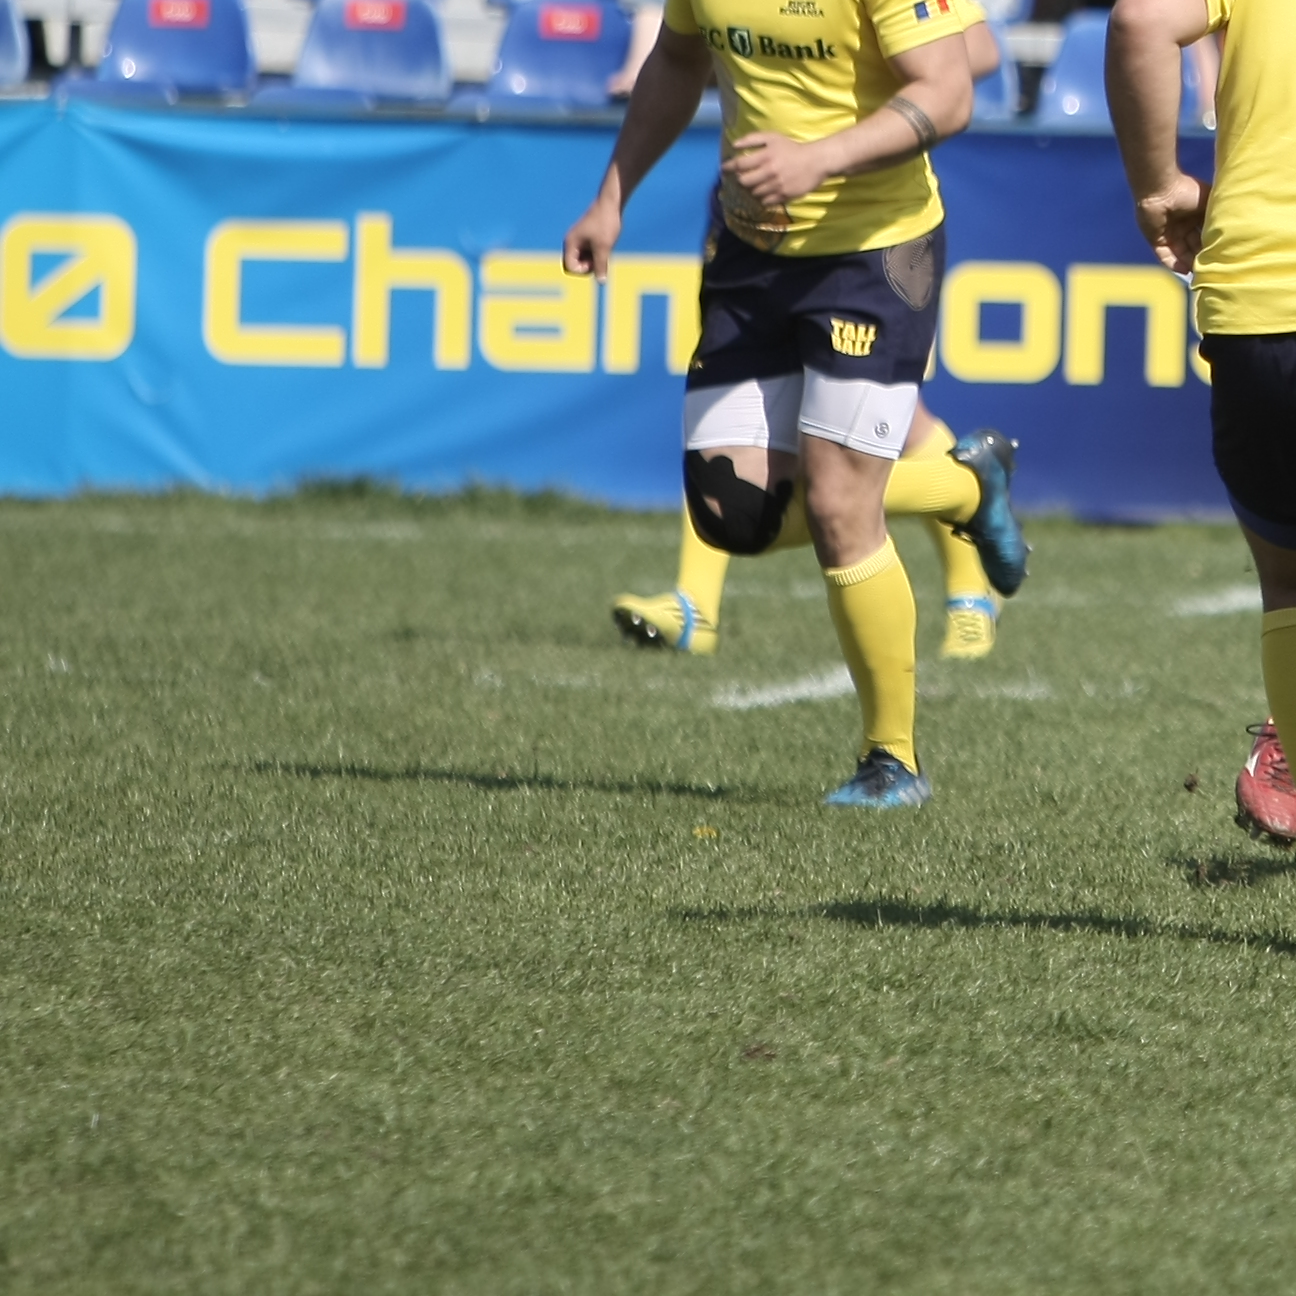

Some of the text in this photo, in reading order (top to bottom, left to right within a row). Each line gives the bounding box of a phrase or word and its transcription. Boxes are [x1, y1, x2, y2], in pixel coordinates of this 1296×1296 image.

[758, 35, 836, 60] Bank
[830, 316, 877, 342] TALL
[831, 332, 872, 357] BALL
